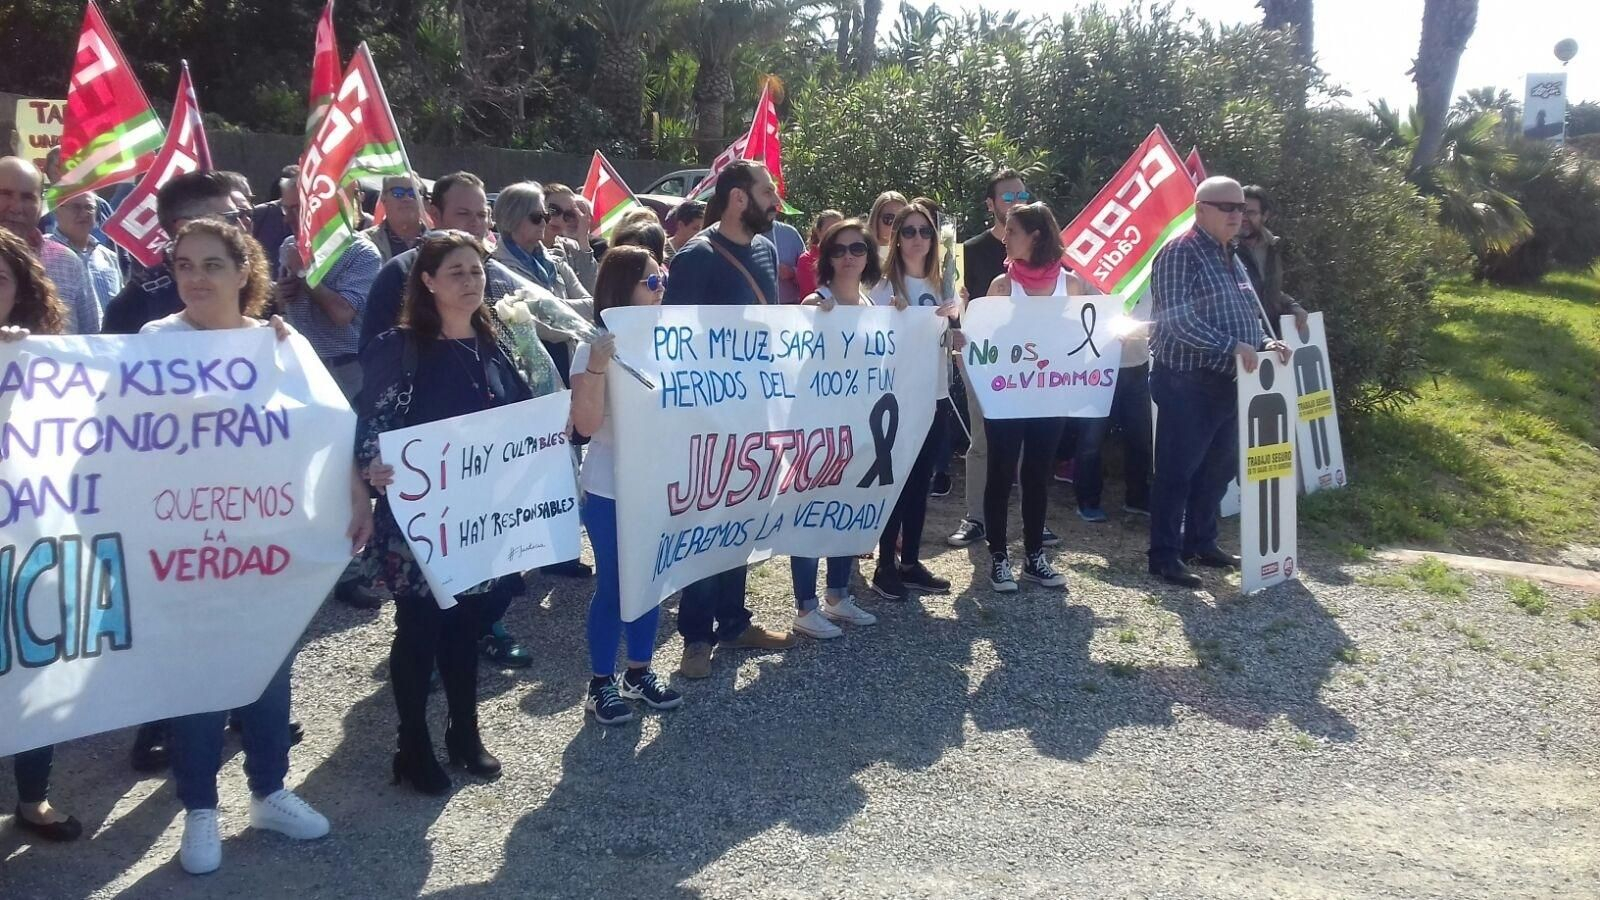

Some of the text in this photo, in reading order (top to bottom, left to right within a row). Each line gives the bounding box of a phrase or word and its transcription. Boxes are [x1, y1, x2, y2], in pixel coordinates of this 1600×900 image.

[653, 326, 698, 361] POR
[841, 330, 855, 359] Y
[864, 329, 896, 356] LOS
[120, 356, 259, 396] KISKO
[660, 367, 896, 408] HERIDOS DEL 100% FUN
[0, 411, 189, 462] NTONIO,
[502, 431, 566, 463] CULPABLES
[667, 425, 855, 516] JUSTICIA
[152, 481, 295, 522] QUEREMOS
[754, 512, 785, 541] LA
[792, 498, 886, 531] VERDAD!
[203, 528, 227, 542] LA
[459, 513, 488, 548] HAY
[490, 497, 575, 537] RESPONSABLES
[148, 544, 291, 582] VERDAD
